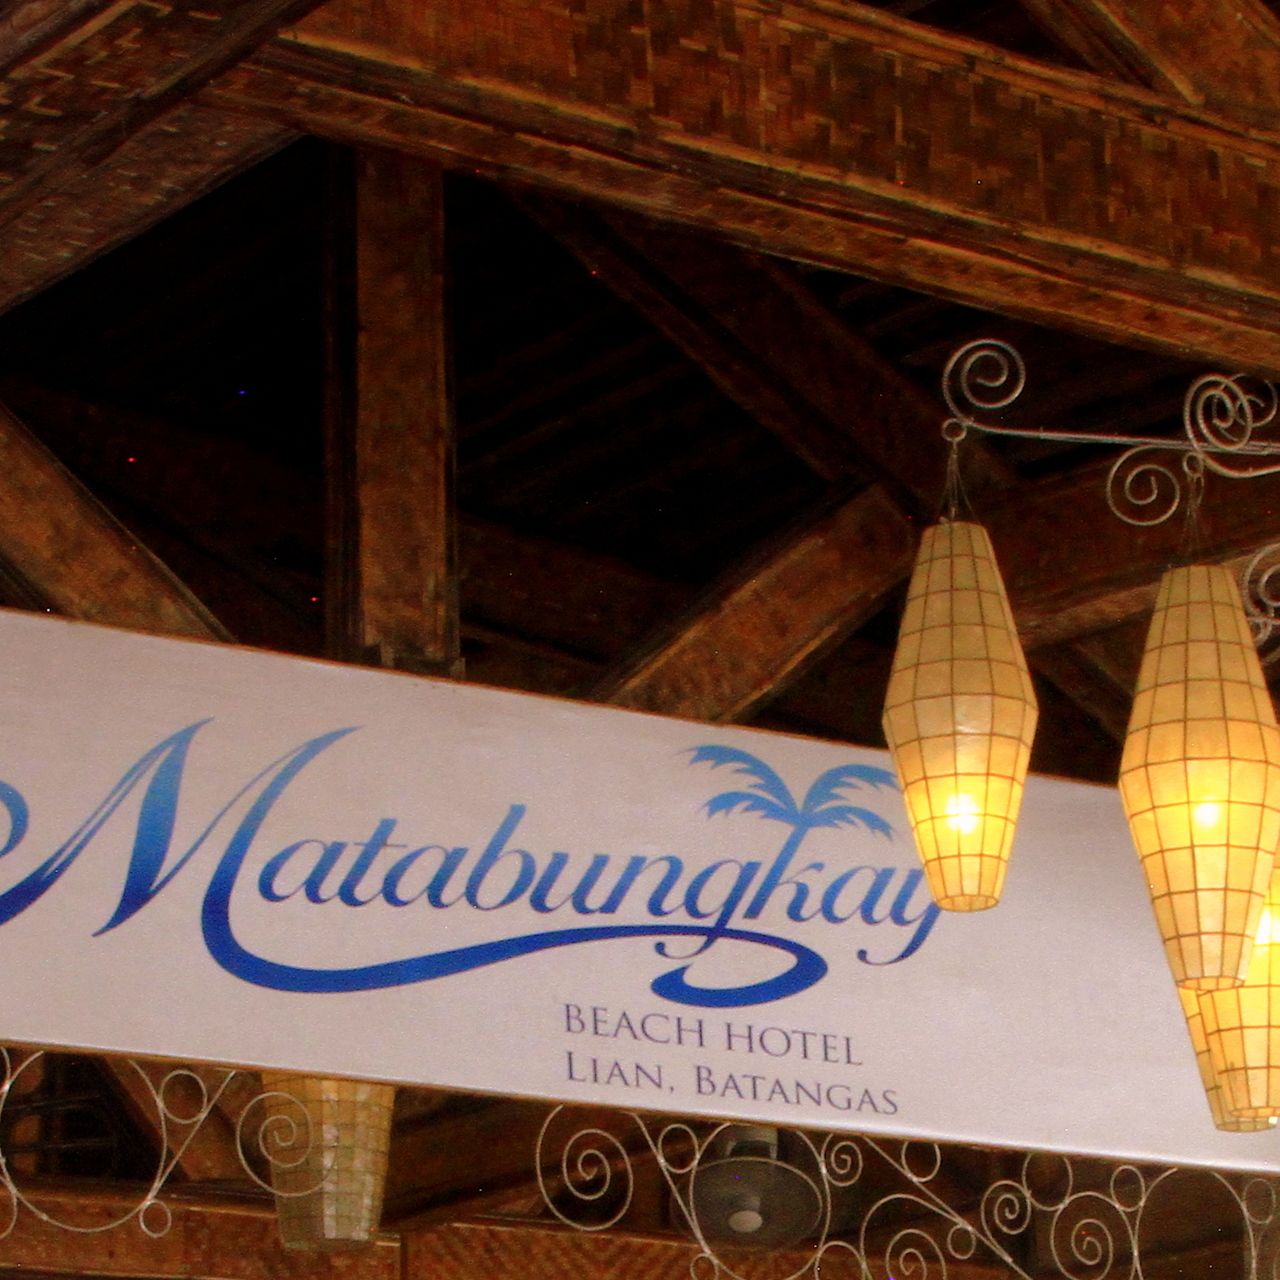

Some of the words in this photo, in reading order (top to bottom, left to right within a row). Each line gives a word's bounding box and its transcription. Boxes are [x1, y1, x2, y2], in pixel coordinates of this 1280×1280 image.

[564, 1003, 705, 1048] BEACH
[725, 1022, 863, 1066] HOTEL
[567, 1051, 675, 1093] LIAN,
[695, 1065, 899, 1116] BATANGAS
